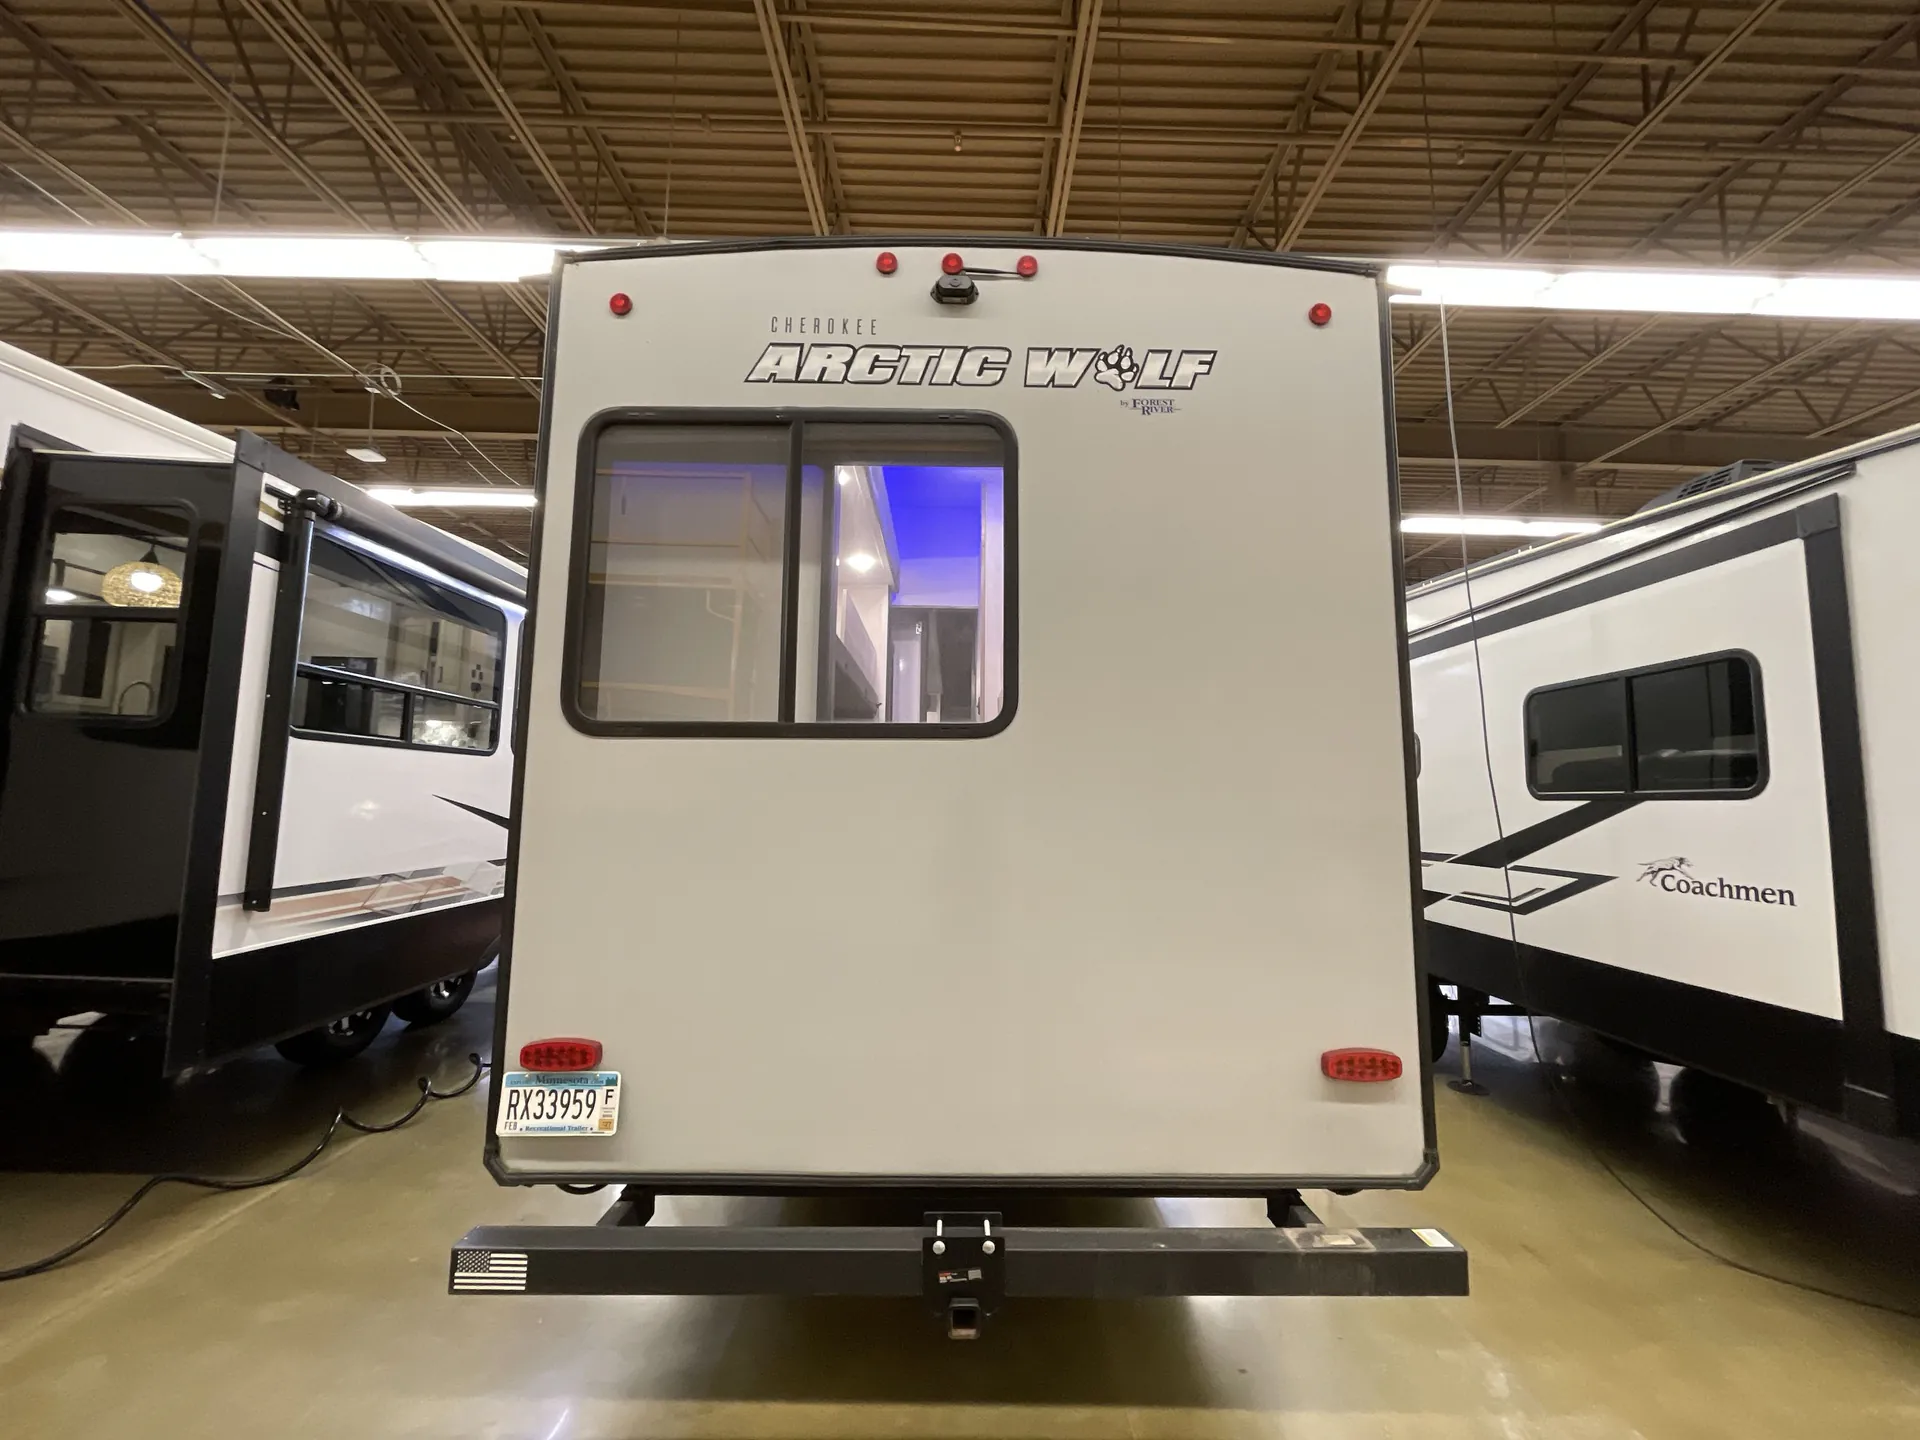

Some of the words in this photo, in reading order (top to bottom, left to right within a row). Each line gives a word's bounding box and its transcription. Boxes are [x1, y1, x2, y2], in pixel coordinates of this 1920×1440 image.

[771, 316, 877, 335] CHEROKEE
[744, 342, 1012, 387] ARCTIC
[1120, 399, 1129, 408] by
[1132, 398, 1175, 408] FOREST
[1141, 405, 1174, 415] RIVER
[1660, 873, 1798, 907] Coachmen
[506, 1089, 597, 1120] RX33959
[604, 1089, 615, 1105] F
